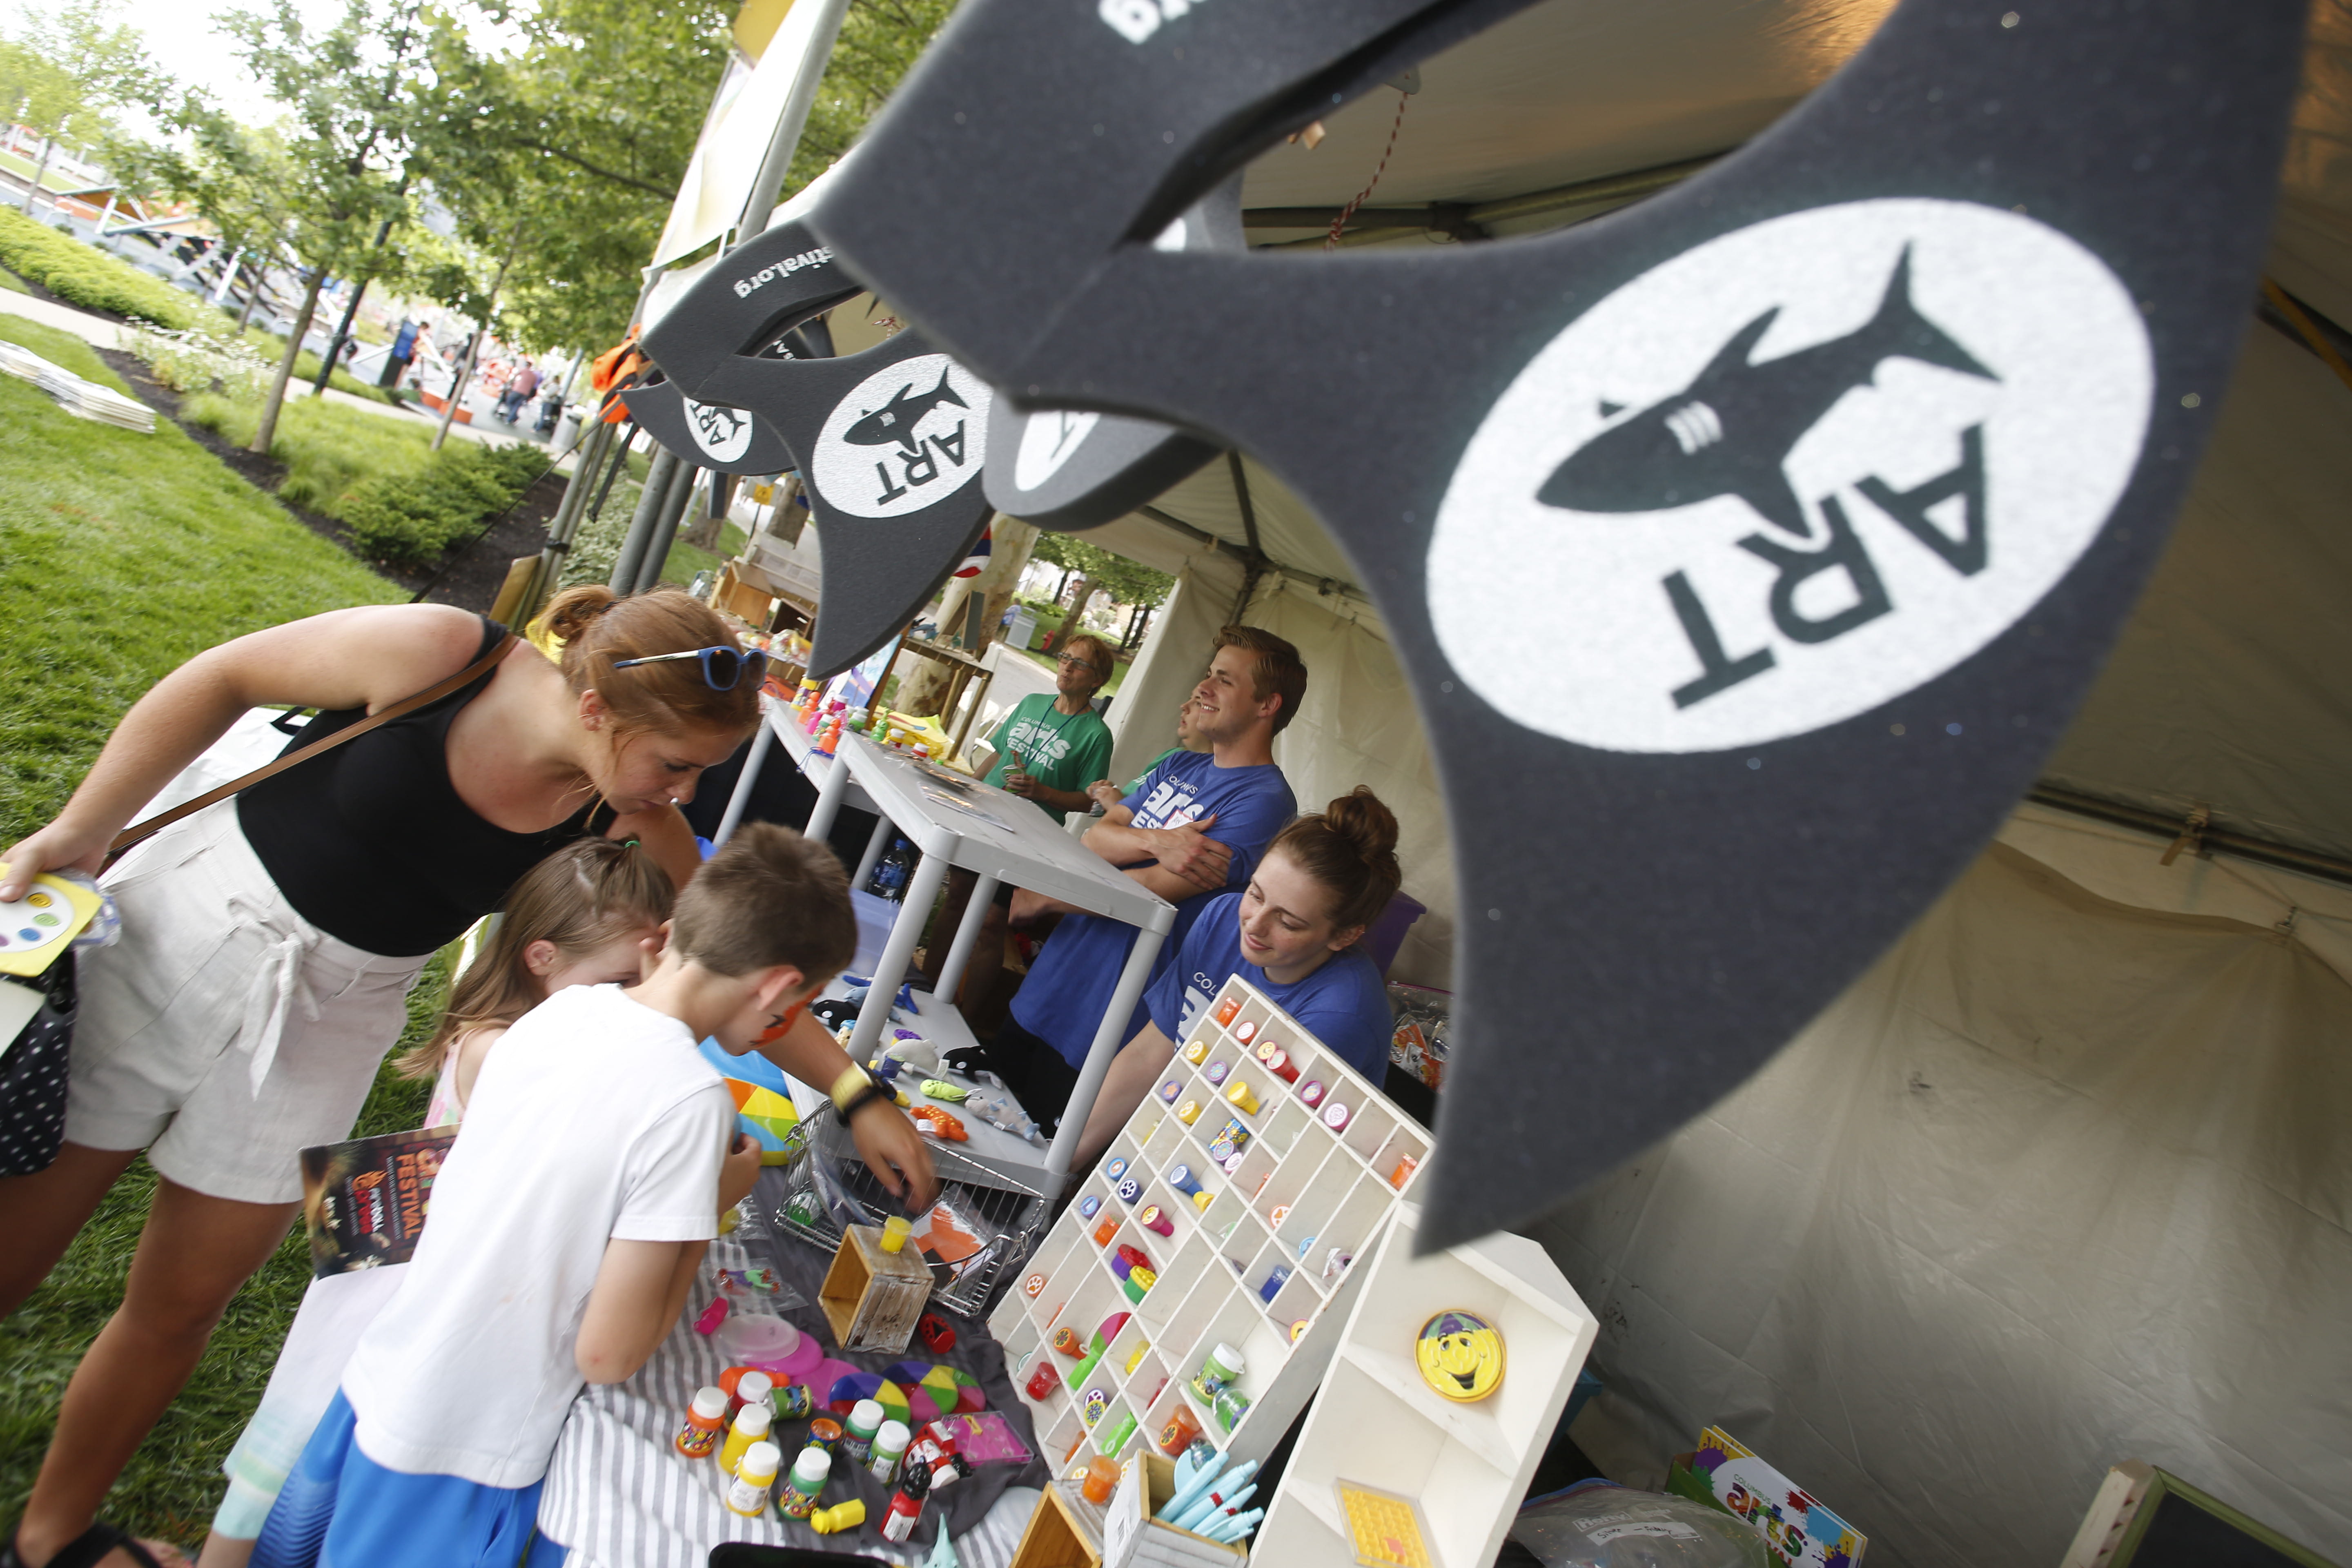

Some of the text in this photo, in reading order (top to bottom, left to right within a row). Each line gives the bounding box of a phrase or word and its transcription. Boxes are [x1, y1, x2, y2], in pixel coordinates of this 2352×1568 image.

[689, 403, 727, 446] ART
[876, 419, 964, 506] ART
[1661, 424, 1989, 710] ART
[1009, 722, 1071, 760] arts
[1193, 972, 1219, 996] COL
[395, 1153, 422, 1240] FESTIVAL
[1733, 1473, 1772, 1505] COLUMBUS
[1579, 1512, 1627, 1530] Hefty
[1726, 1482, 1805, 1557] arts
